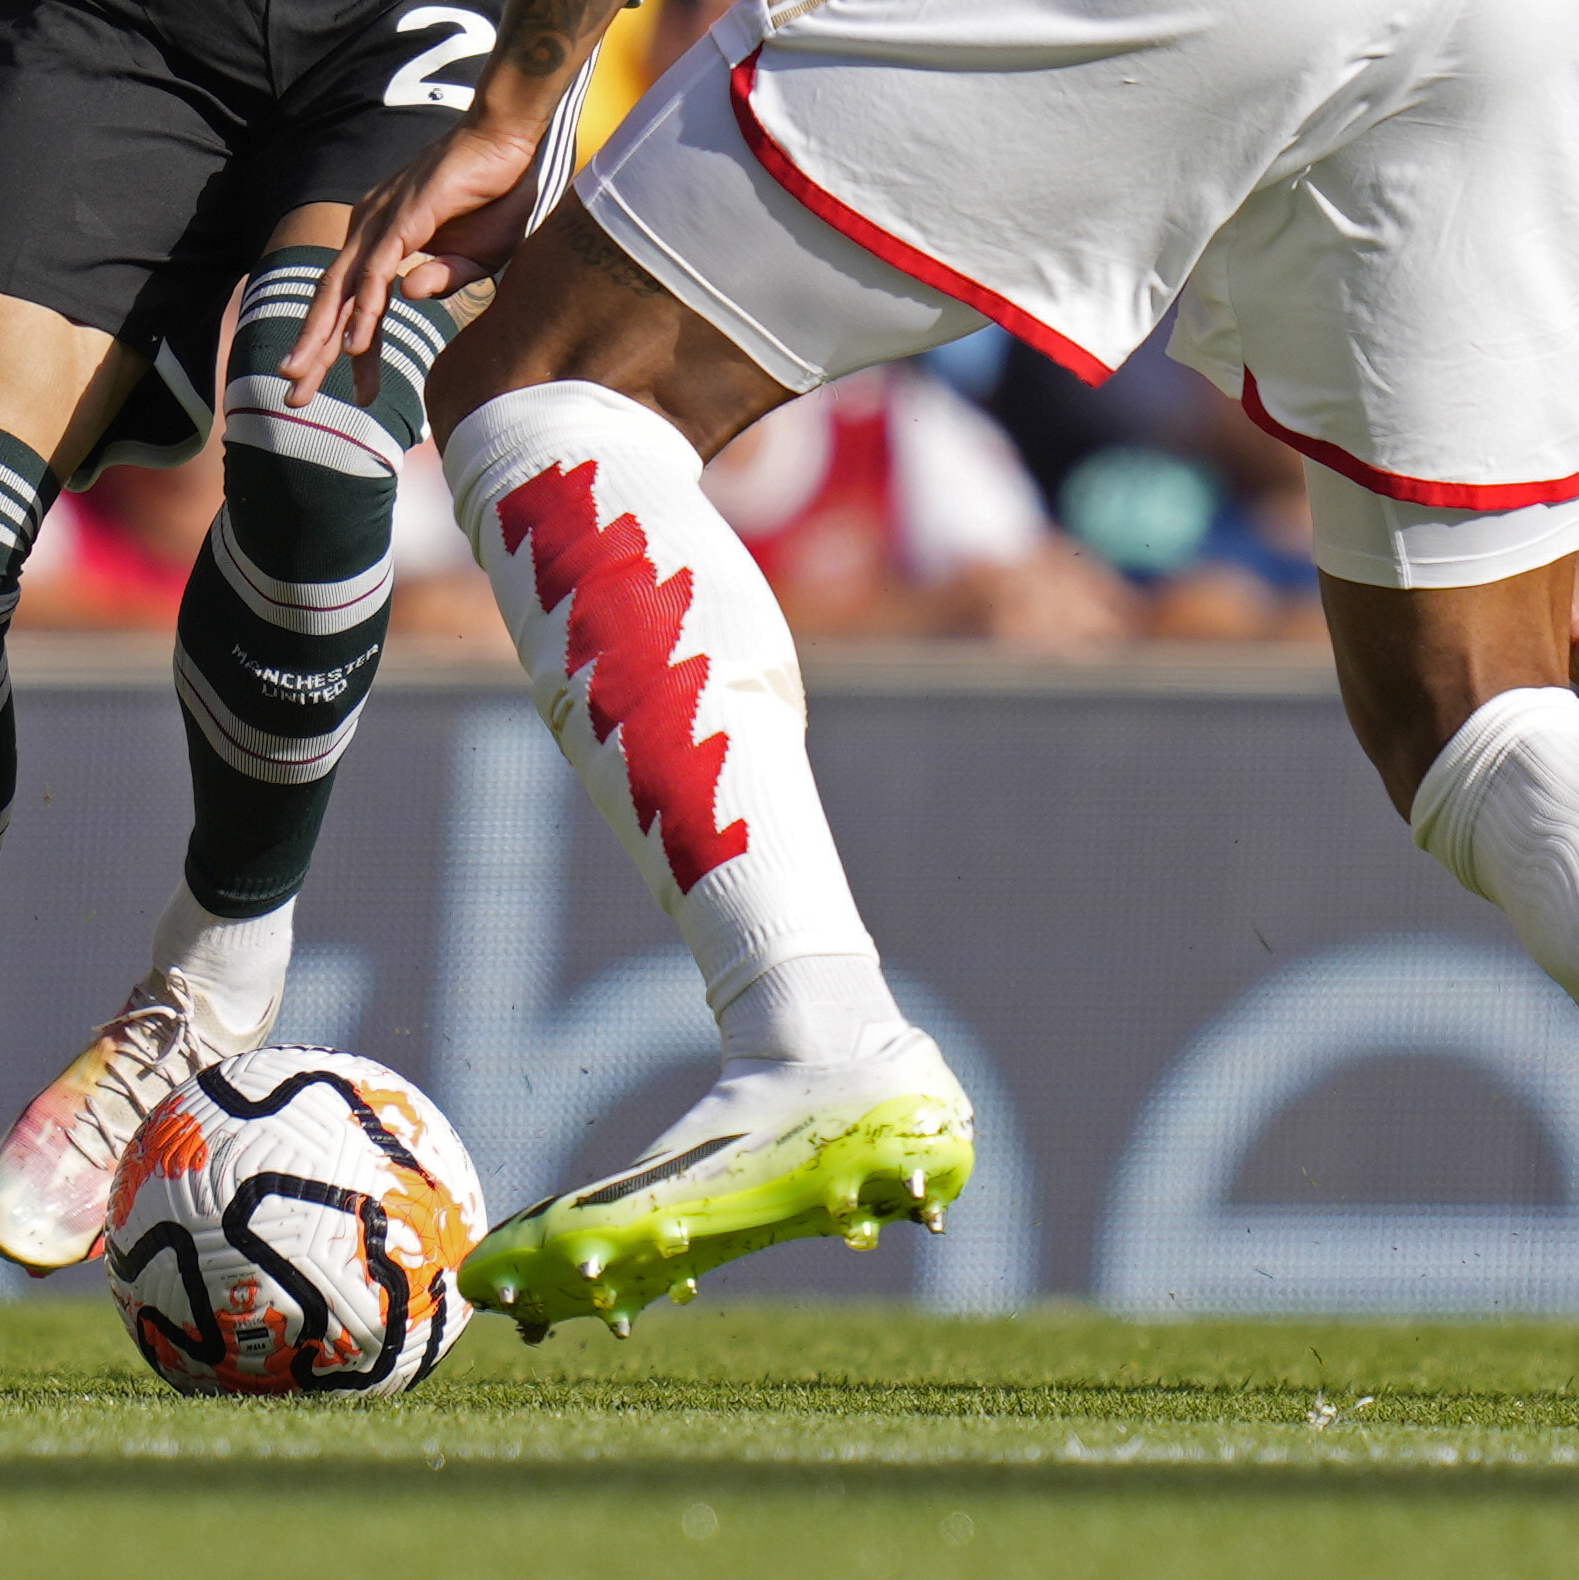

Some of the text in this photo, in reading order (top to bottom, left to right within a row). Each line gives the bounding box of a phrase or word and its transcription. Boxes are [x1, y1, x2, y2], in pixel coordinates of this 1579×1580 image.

[383, 5, 498, 112] 2
[231, 643, 380, 690] MANCHESTER
[261, 678, 348, 706] UNITED
